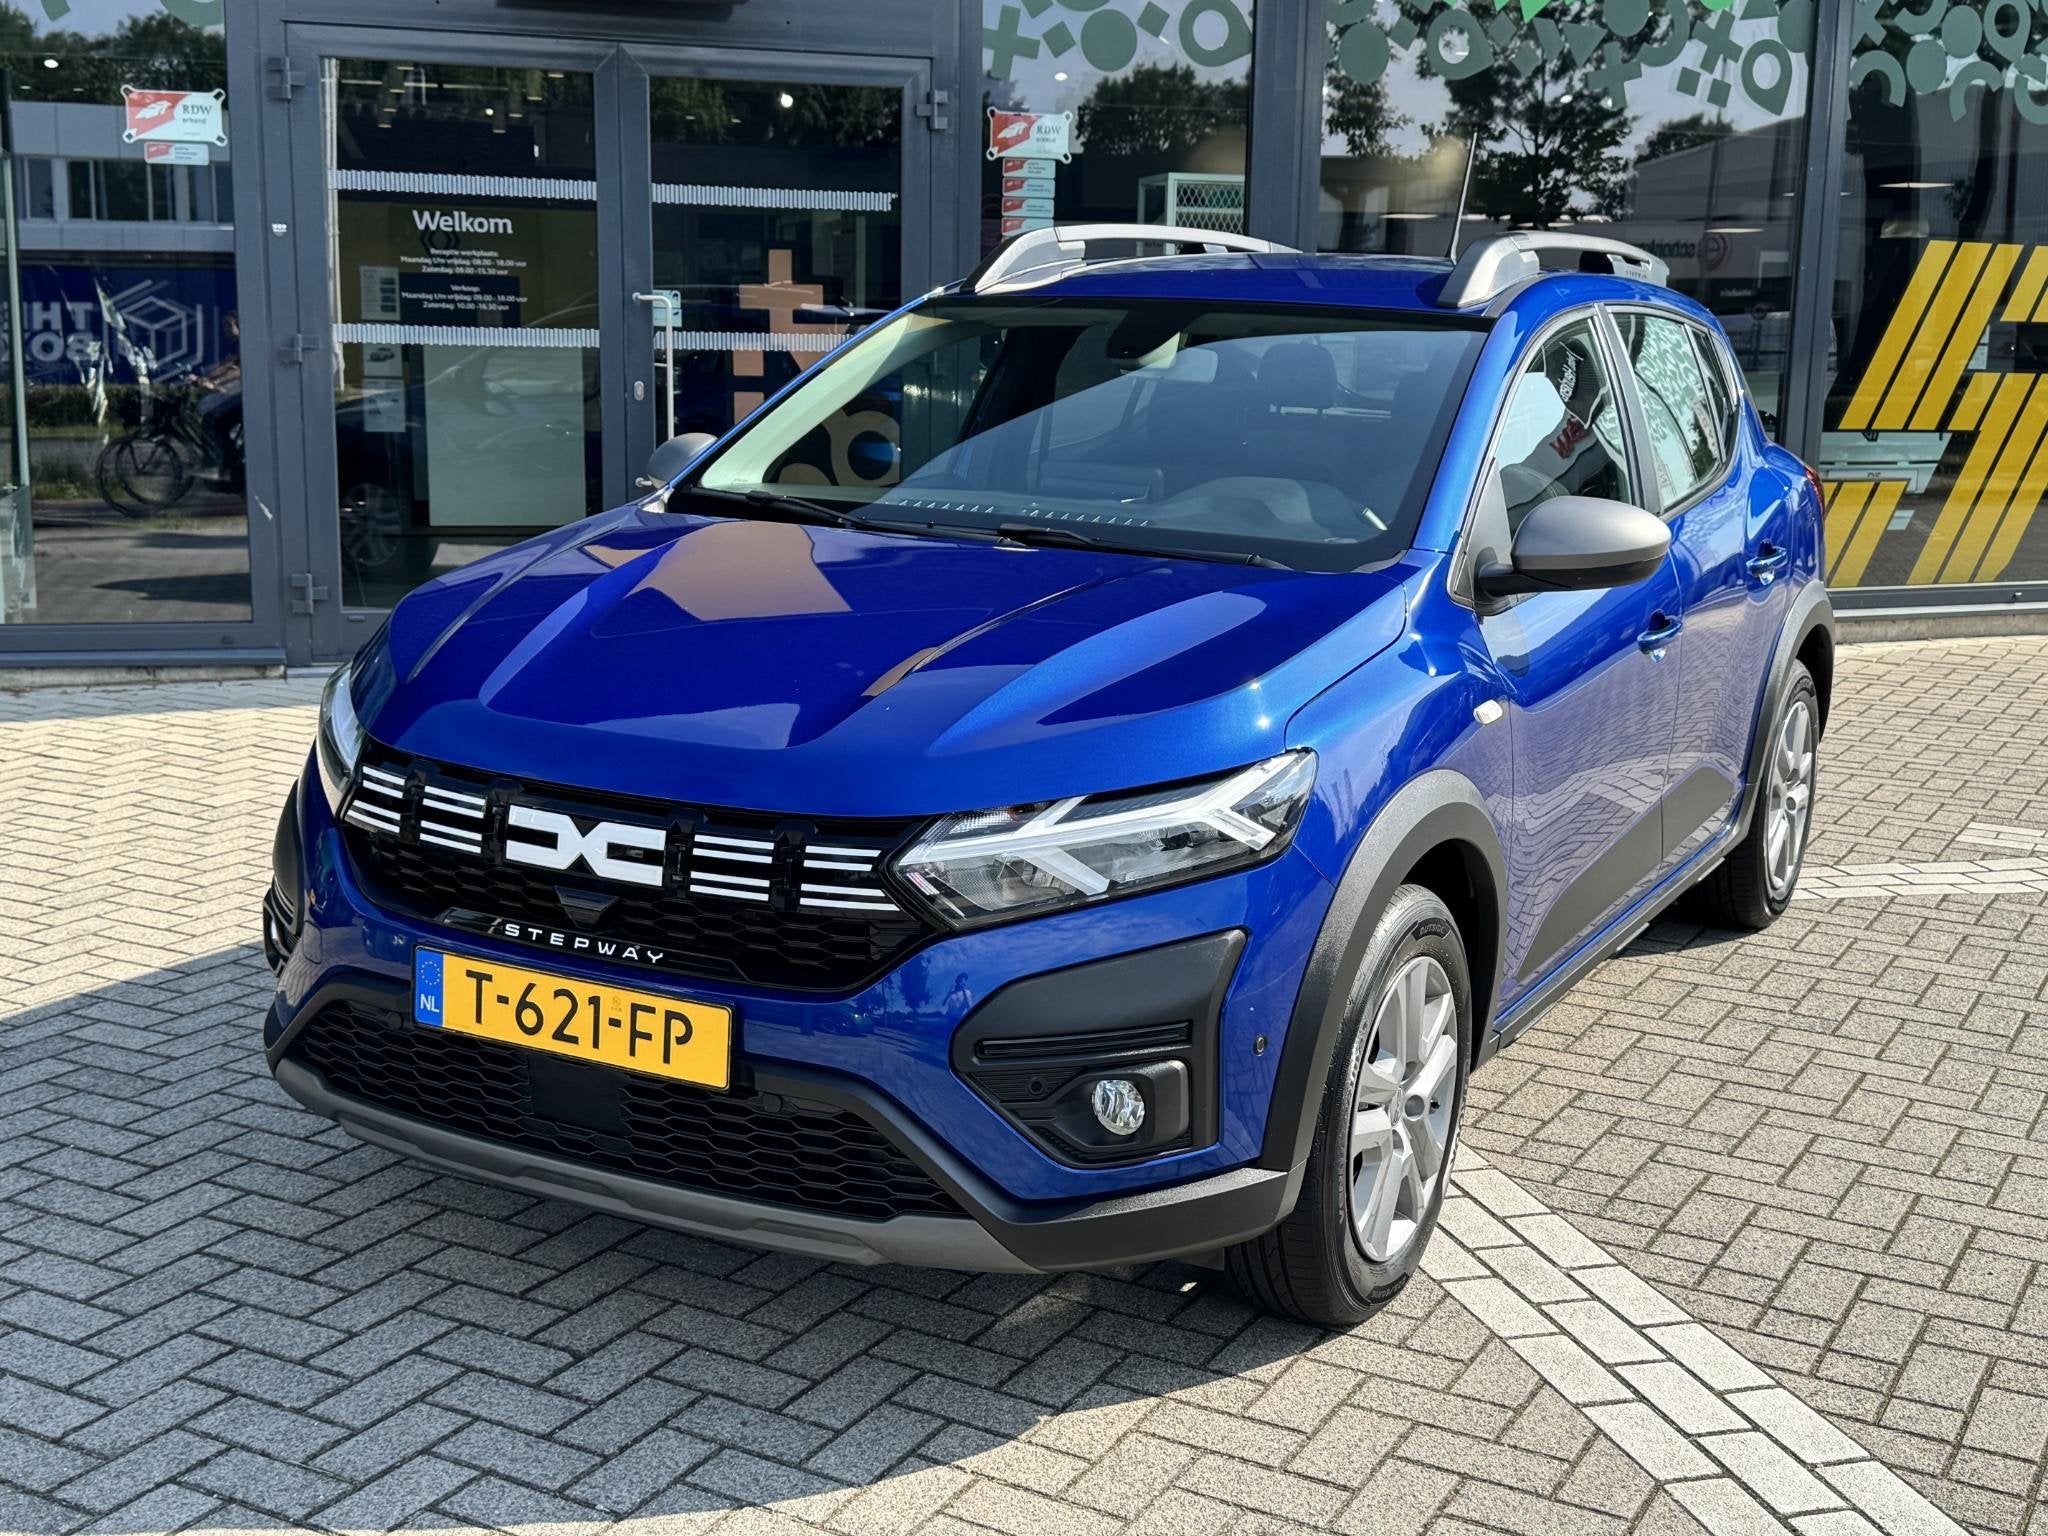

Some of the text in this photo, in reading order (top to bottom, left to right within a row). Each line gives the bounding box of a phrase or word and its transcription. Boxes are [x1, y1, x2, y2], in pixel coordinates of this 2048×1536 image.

[182, 104, 212, 115] RDW
[1036, 124, 1061, 136] RDW
[412, 209, 513, 234] Welkom
[400, 256, 432, 265] Maandag
[401, 292, 433, 300] Maandag
[504, 923, 664, 964] STEPWAY
[420, 992, 440, 1014] NL
[465, 969, 694, 1065] T-621-FP
